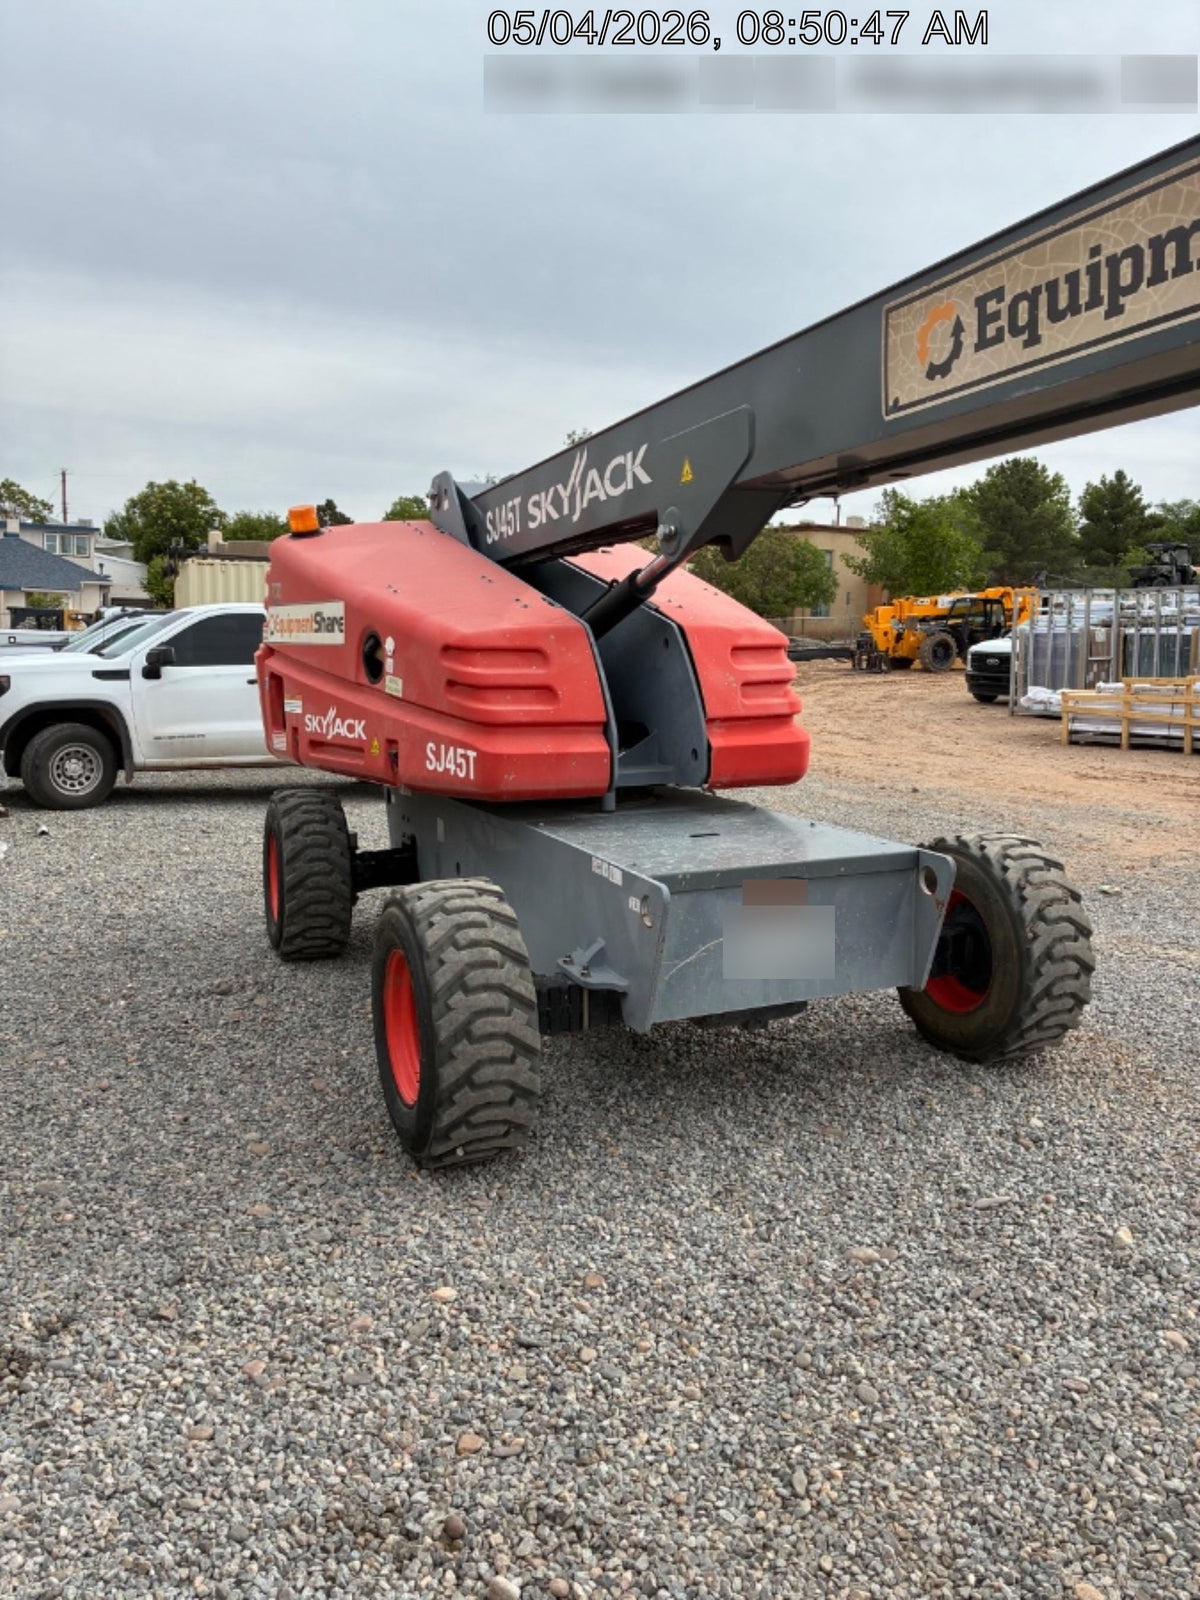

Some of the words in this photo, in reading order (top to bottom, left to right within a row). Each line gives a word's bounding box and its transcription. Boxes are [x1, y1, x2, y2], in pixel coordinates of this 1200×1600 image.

[486, 496, 522, 545] SJ45T
[527, 443, 653, 530] SKYJACK
[305, 706, 367, 740] SKYJACK
[426, 742, 477, 780] SJ45T
